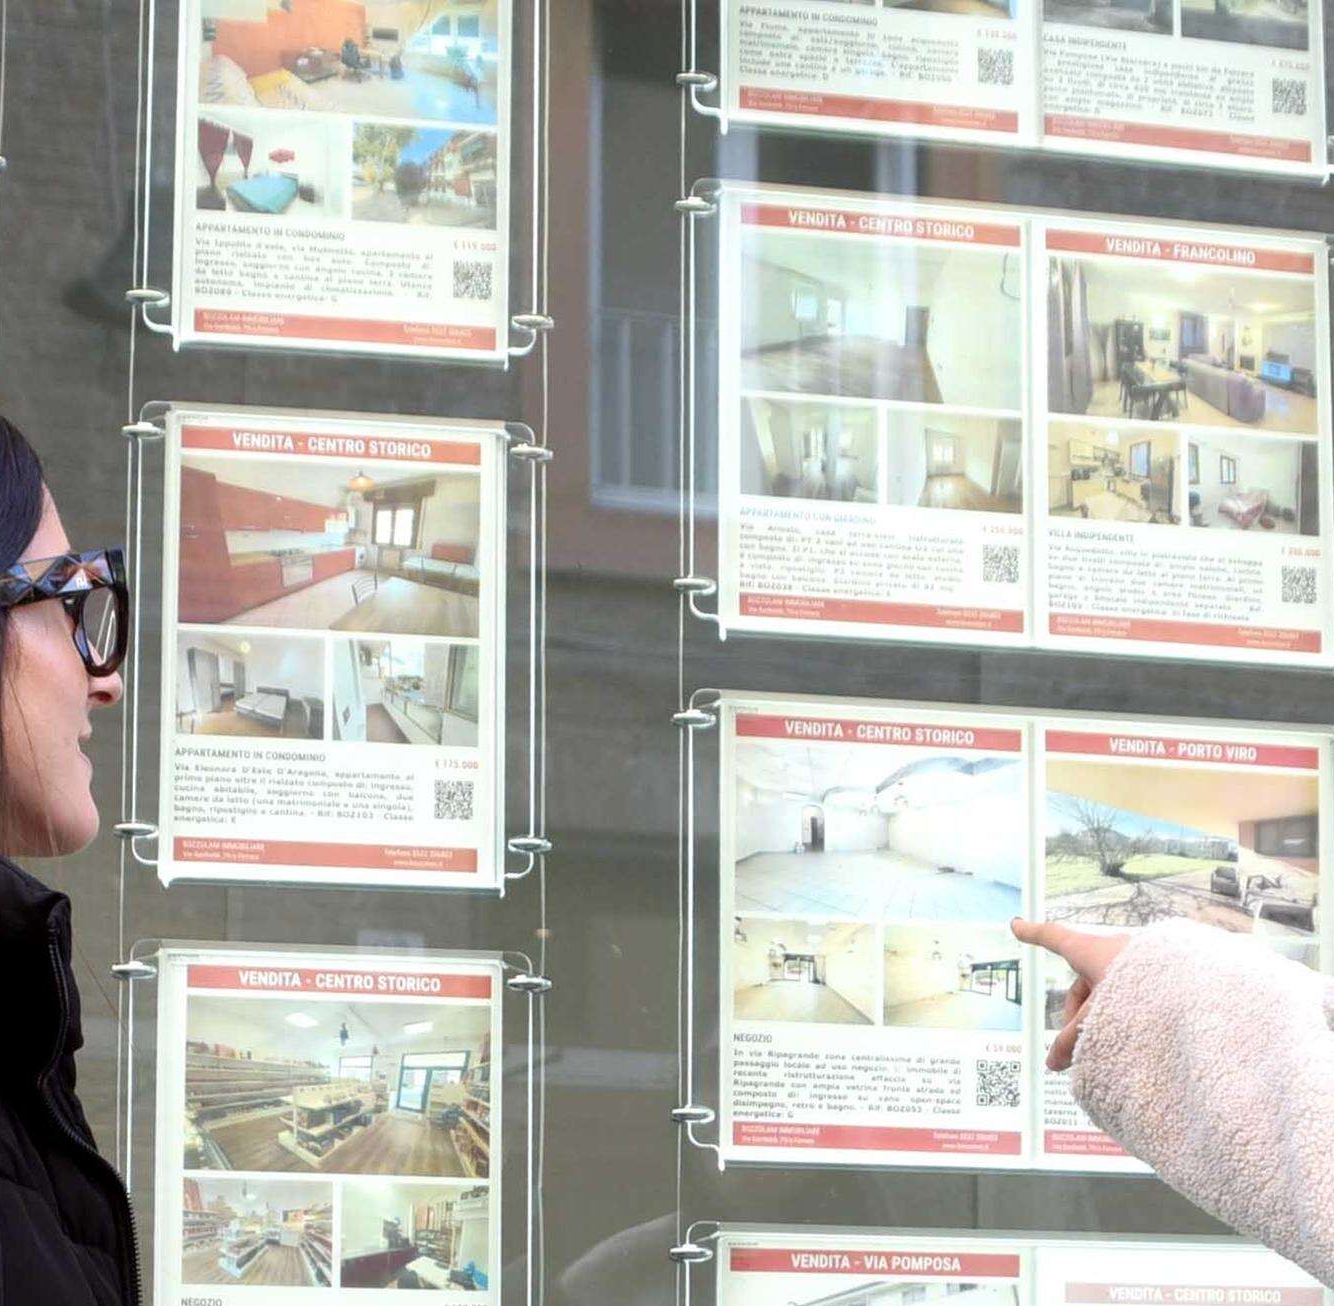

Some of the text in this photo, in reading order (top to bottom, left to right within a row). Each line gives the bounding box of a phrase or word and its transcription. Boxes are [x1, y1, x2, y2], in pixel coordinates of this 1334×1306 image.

[194, 221, 345, 241] APPARTAMENTO IN CONDOMINIO
[787, 210, 975, 239] VENDITA CENTRO STORICO
[1105, 236, 1255, 265] VENDITA FRANCOLINO
[231, 431, 294, 450] VENDITA
[307, 435, 365, 455] CENTRO
[368, 439, 431, 458] STORICO
[784, 720, 844, 737] VENDITA
[856, 723, 912, 742] CENTRO
[914, 726, 974, 746] STORICO
[173, 746, 326, 763] APPARTAMENTO IN CONDOMINIO
[1109, 737, 1166, 755] VENDITA
[1177, 741, 1223, 759] PORTO
[1225, 745, 1257, 761] VIRO
[238, 969, 302, 987] VENDITA
[315, 972, 374, 990] CENTRO
[377, 974, 441, 992] STORICO
[732, 1032, 773, 1044] NEGOZIO
[790, 1252, 851, 1269] VENDITA
[863, 1254, 888, 1270] VIA
[890, 1254, 961, 1272] POMPOSA
[1108, 1284, 1164, 1302] VENDITA
[1173, 1286, 1225, 1303] CENTRO
[1226, 1288, 1281, 1303] STORICO
